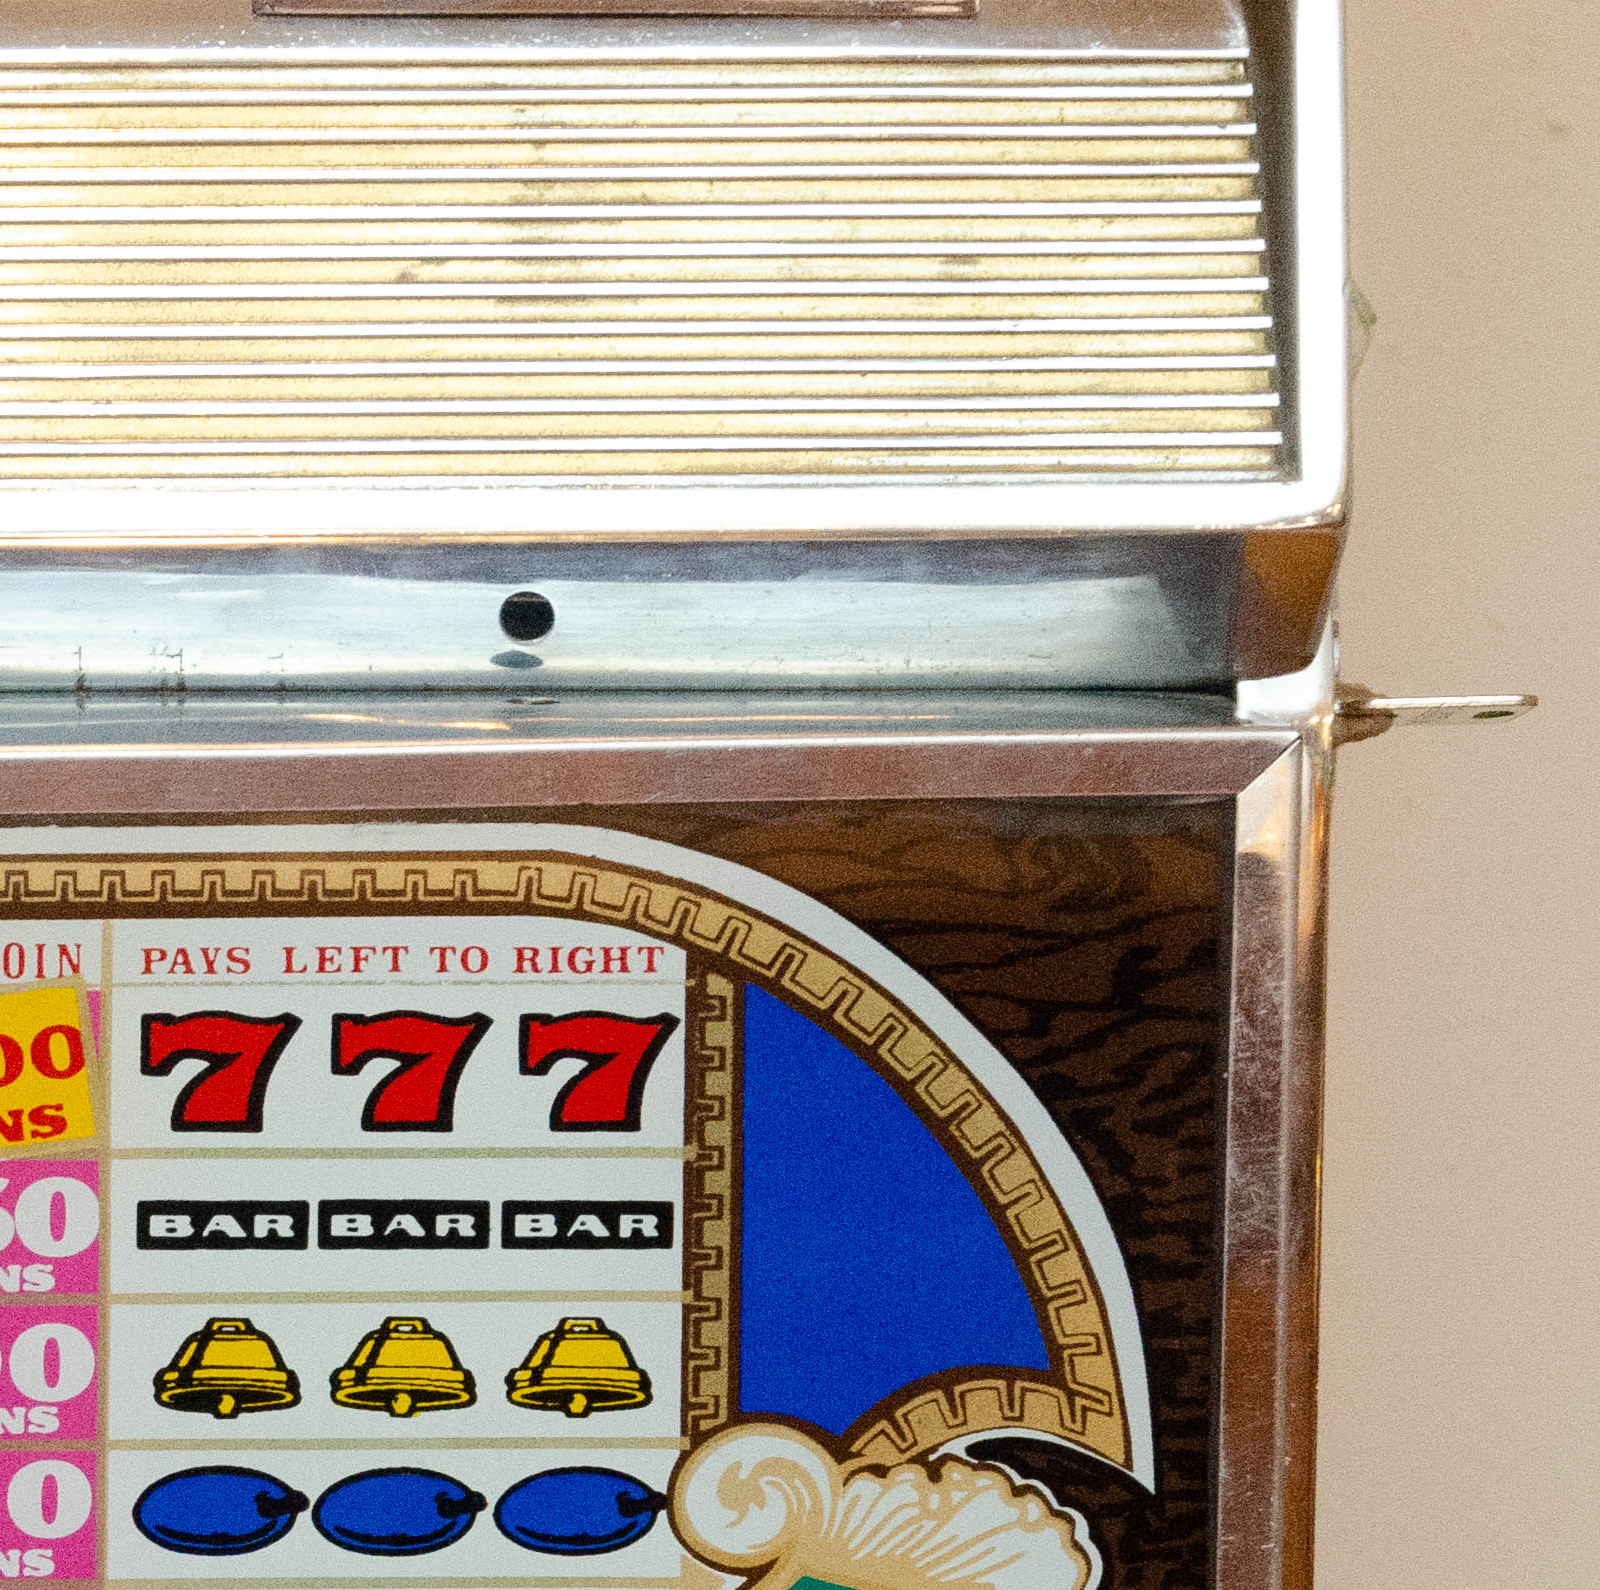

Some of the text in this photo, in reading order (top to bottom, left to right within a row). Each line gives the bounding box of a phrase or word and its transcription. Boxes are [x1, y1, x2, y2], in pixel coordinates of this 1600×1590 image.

[141, 945, 664, 975] PAYS LEFT TO RIGHT
[140, 1009, 681, 1134] 7 7 7
[149, 1212, 659, 1239] BAR BAR BAR
